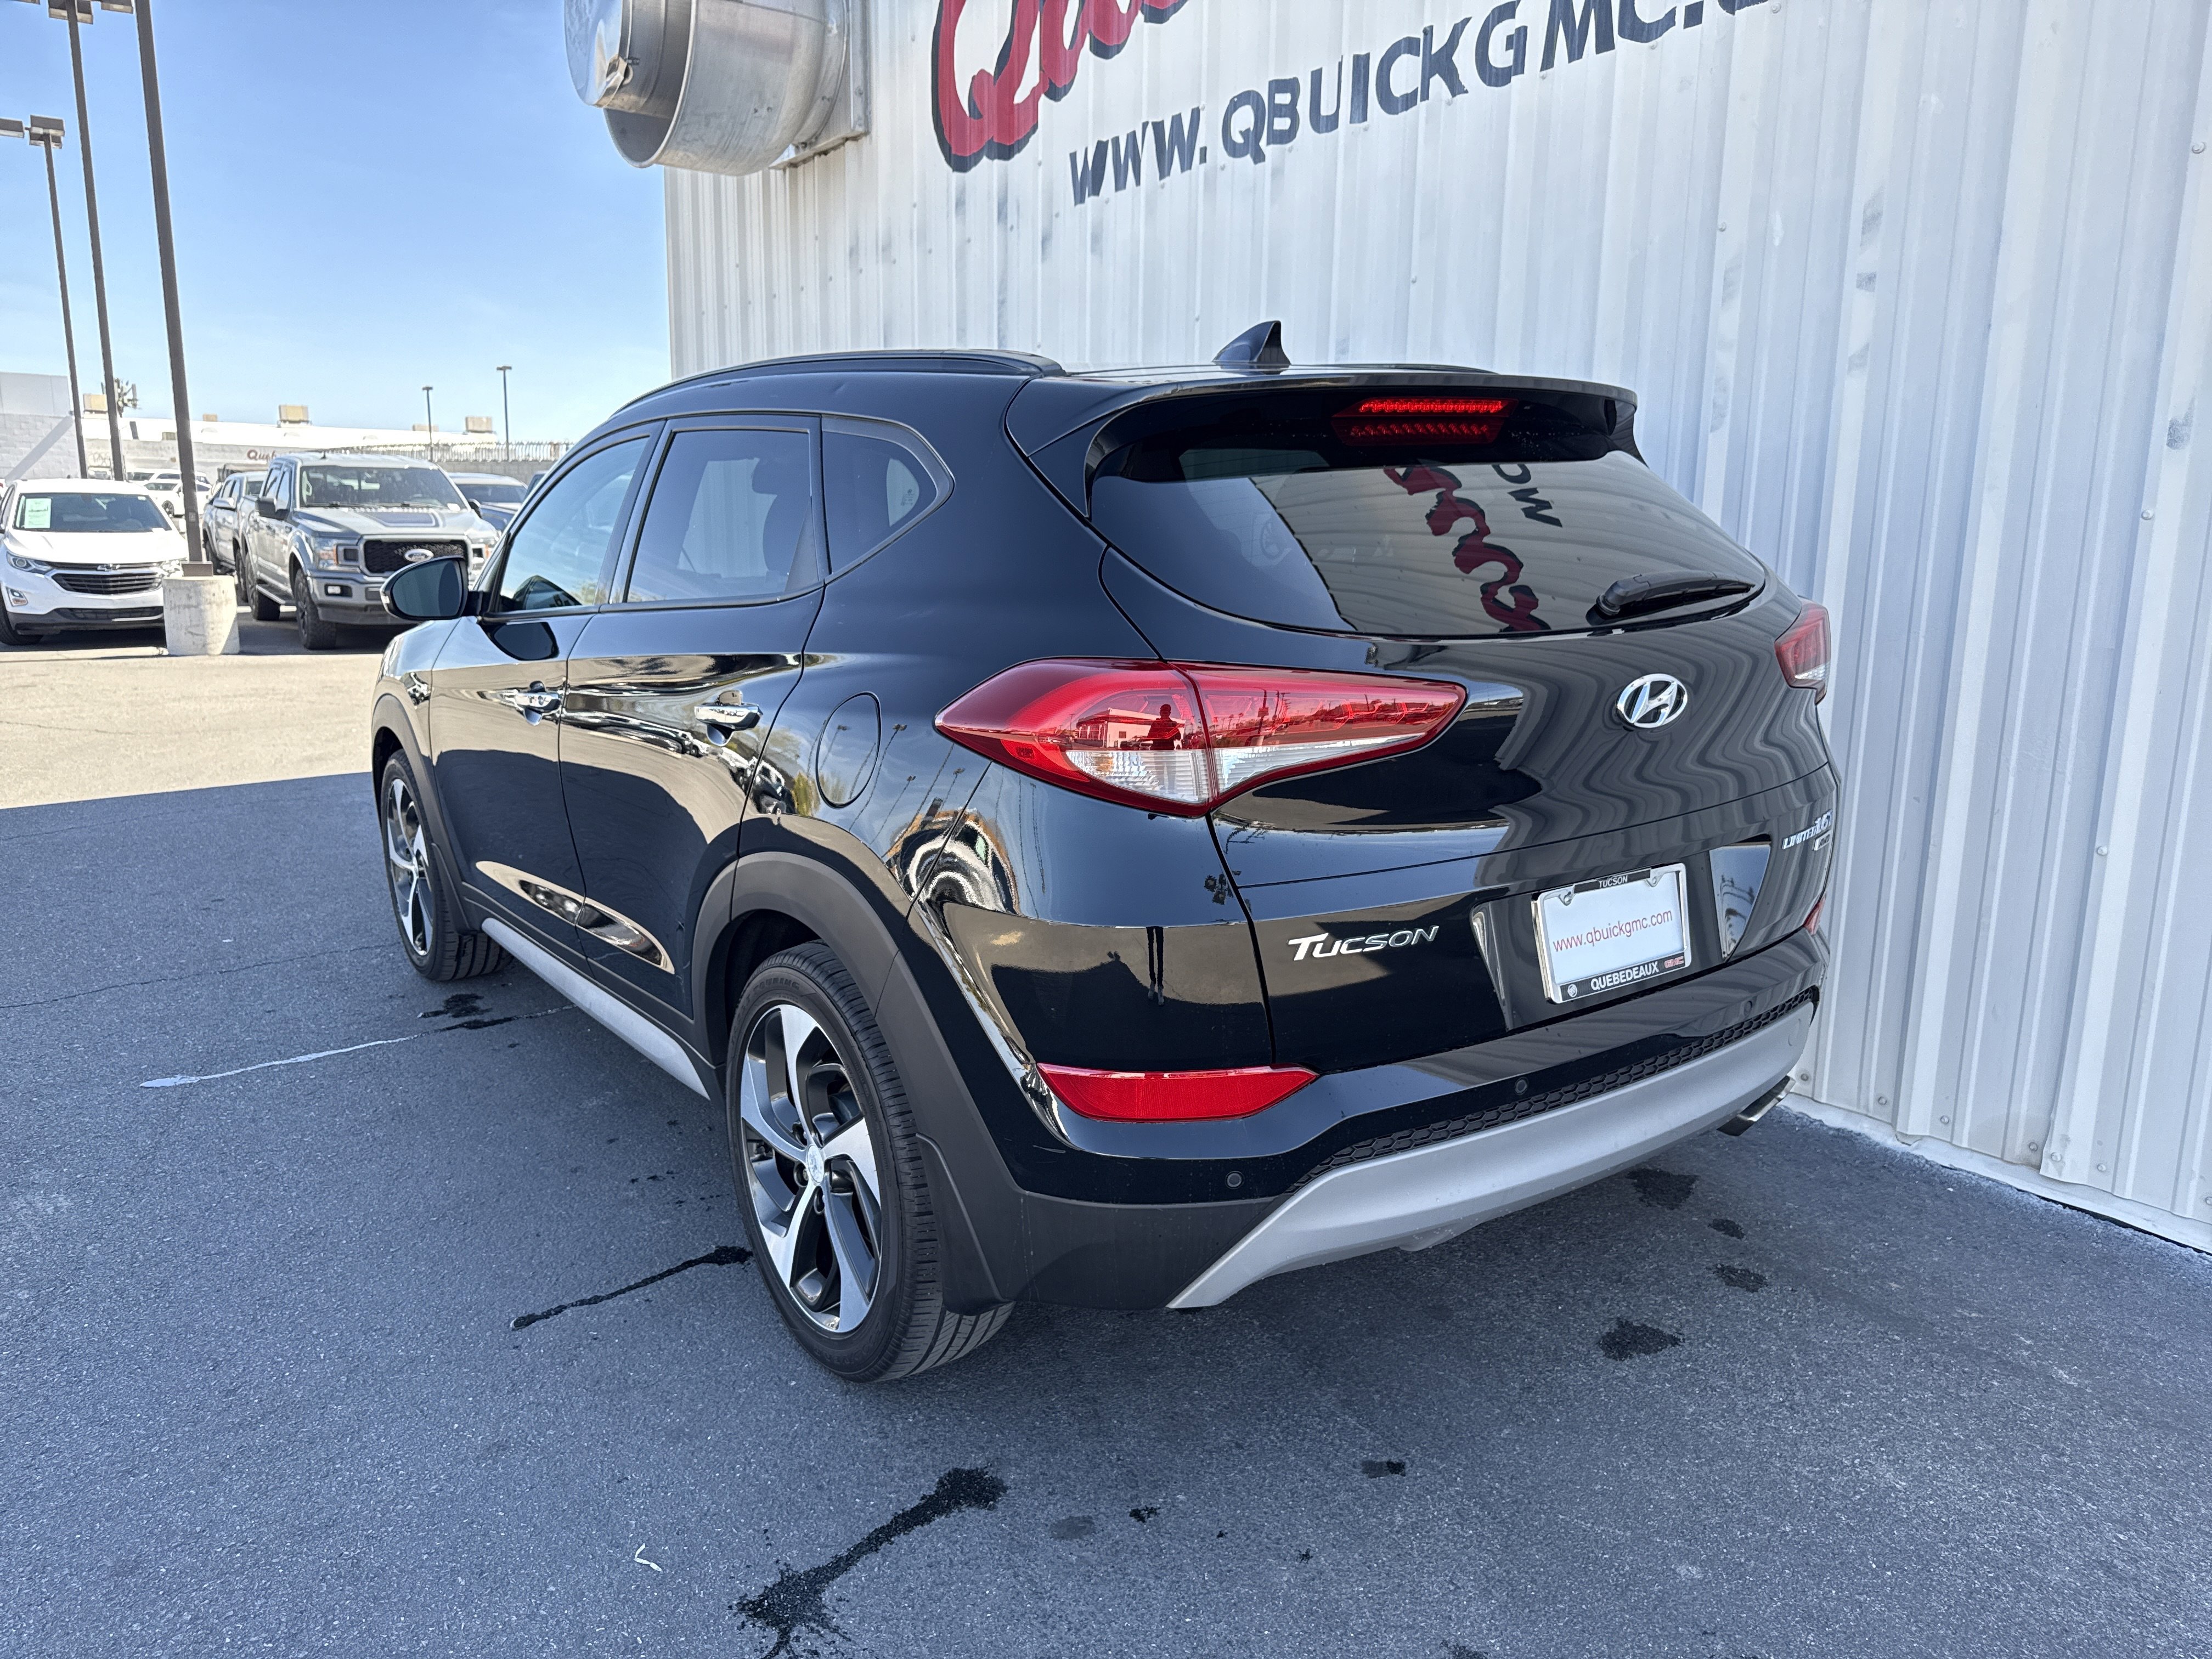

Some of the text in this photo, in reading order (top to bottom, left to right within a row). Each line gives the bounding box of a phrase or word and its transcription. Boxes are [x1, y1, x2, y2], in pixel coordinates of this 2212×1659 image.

[1782, 826, 1817, 850] LIMITED
[1599, 875, 1628, 888] TUCSON
[1287, 925, 1440, 961] TUCSON
[1553, 910, 1673, 952] www.qbuickgmc.com
[1590, 956, 1684, 991] QUEBEDEAUX GMC
